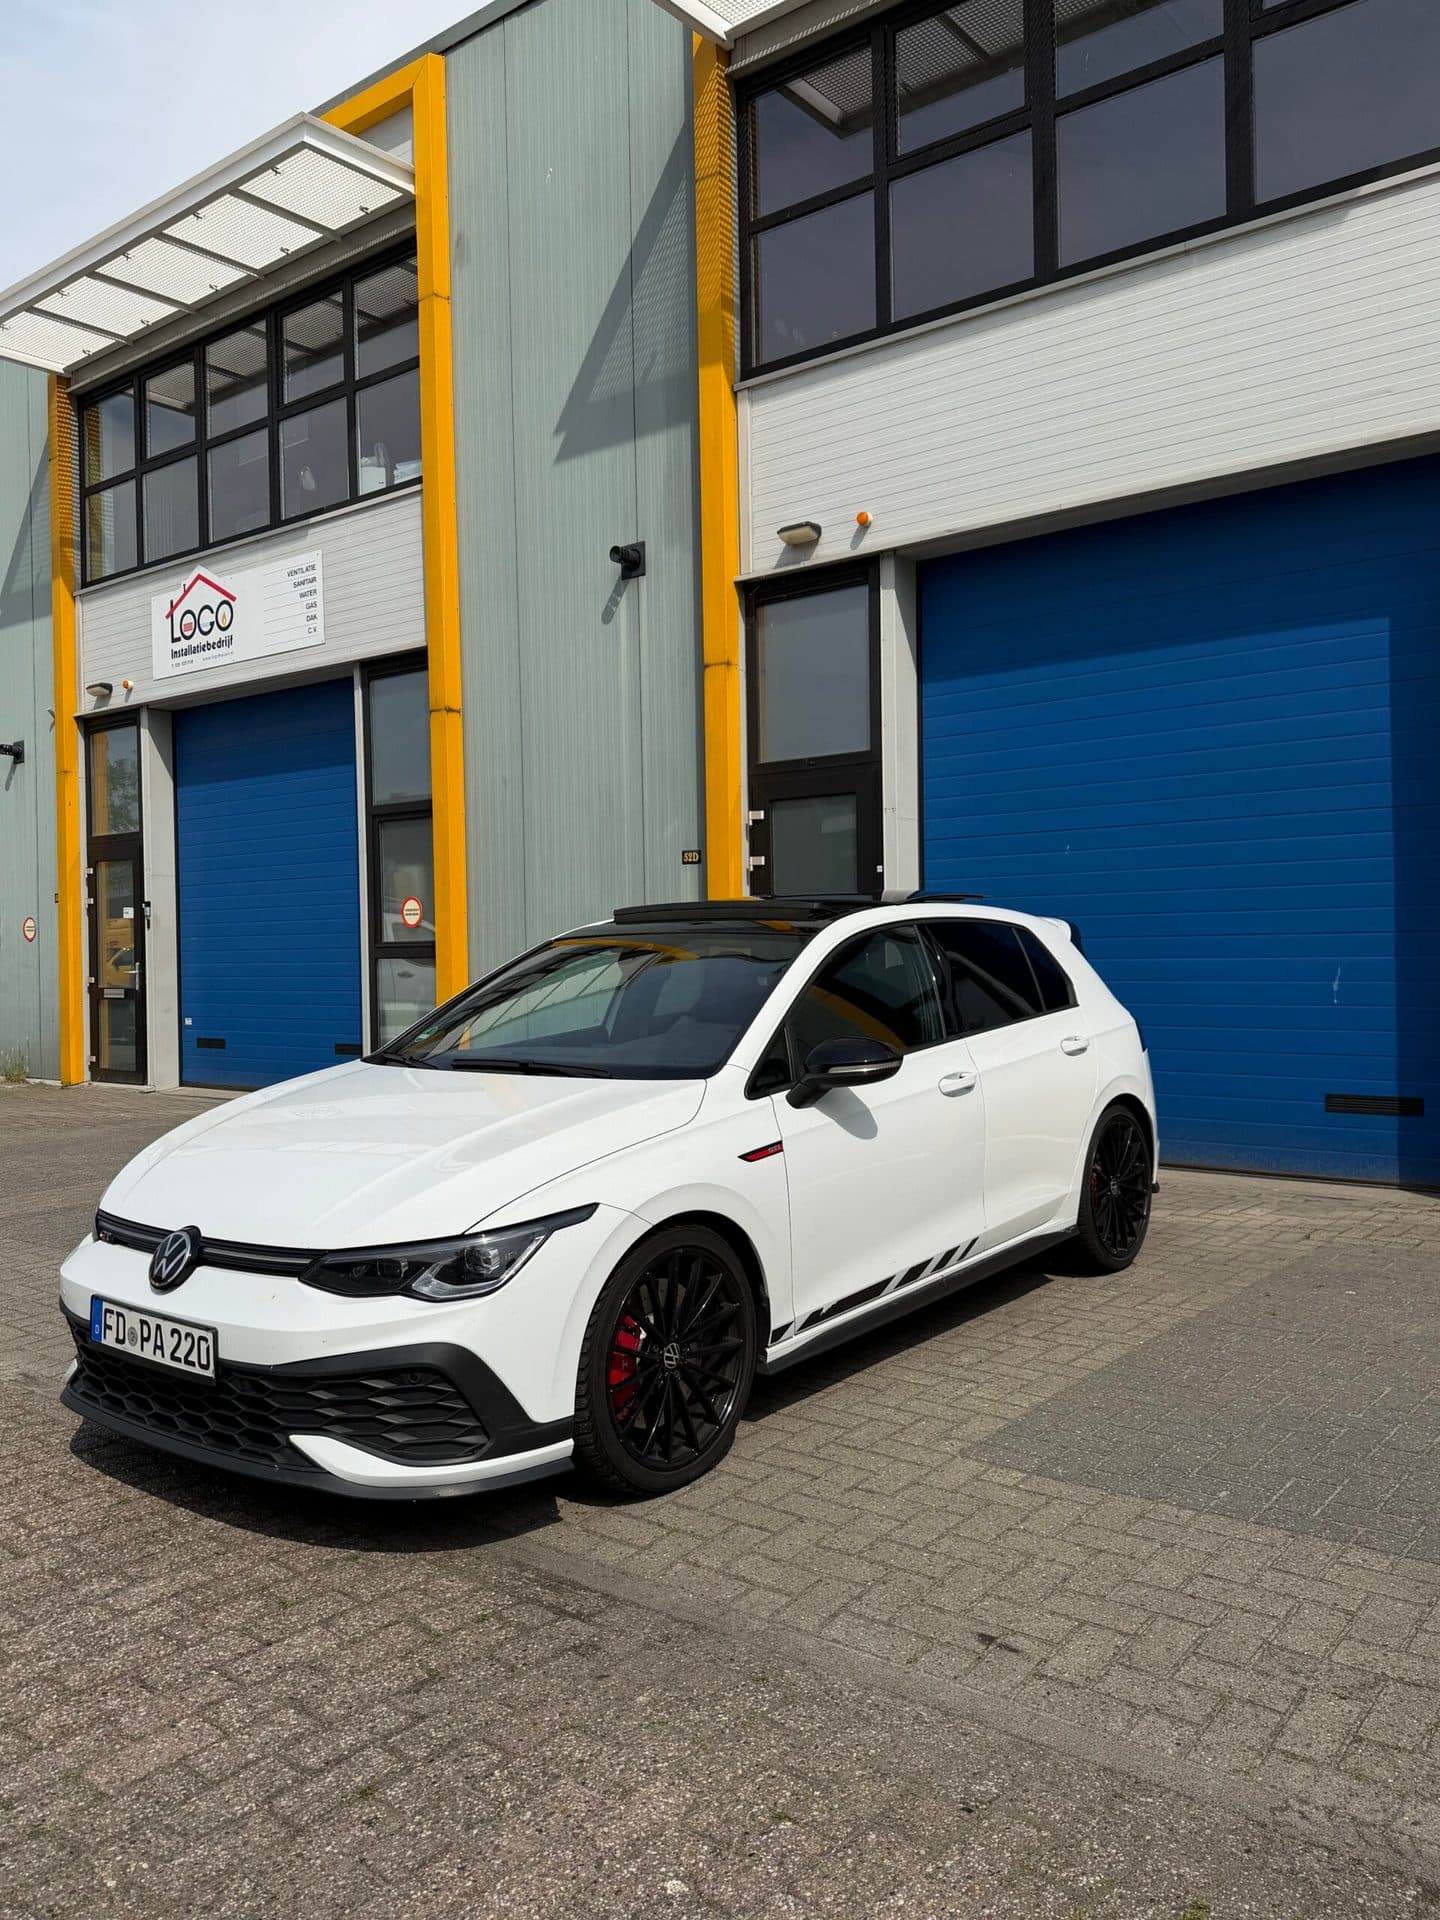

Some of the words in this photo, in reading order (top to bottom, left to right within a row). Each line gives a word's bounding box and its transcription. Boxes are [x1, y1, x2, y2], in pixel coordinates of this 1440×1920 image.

[287, 564, 316, 577] VENTILATIE
[293, 576, 317, 588] SANITAIR
[299, 589, 317, 599] WATER
[305, 601, 317, 610] GAS
[170, 599, 233, 643] LOGO
[306, 613, 318, 622] DAK
[171, 634, 233, 659] Installatiebedrijf
[104, 1308, 126, 1345] FD
[139, 1318, 165, 1358] PA
[170, 1328, 210, 1371] 220
